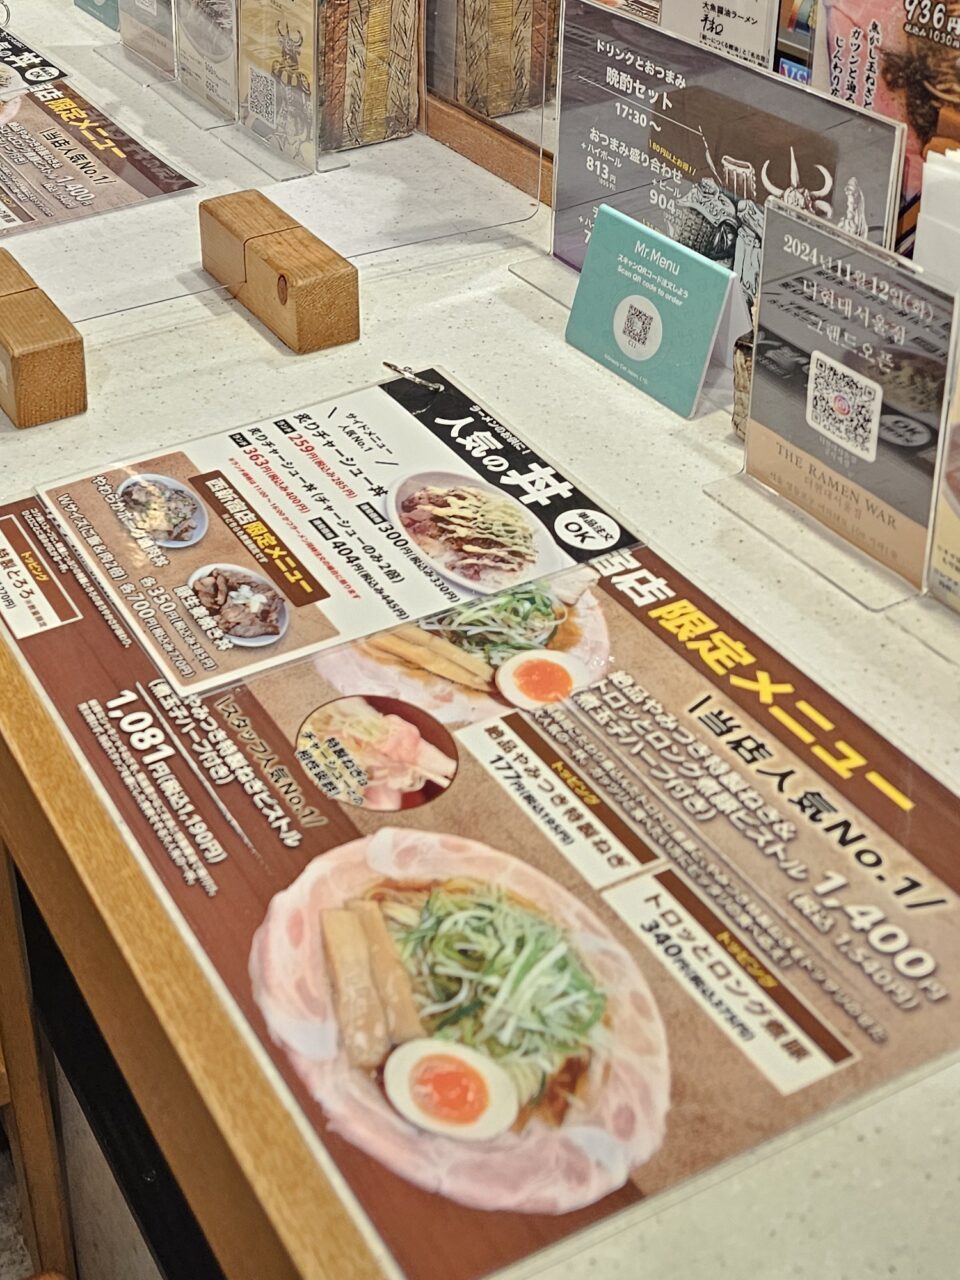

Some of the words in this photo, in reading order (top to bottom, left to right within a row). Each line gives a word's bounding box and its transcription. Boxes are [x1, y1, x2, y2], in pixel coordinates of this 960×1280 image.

[596, 39, 687, 89] ドリンクとおつまみ
[605, 66, 673, 111] 晩酌セット
[586, 156, 617, 184] 813円
[589, 127, 683, 184] おつまみ盛り合わせ
[617, 265, 632, 277] Scan
[642, 278, 657, 292] code
[665, 292, 683, 306] order
[634, 240, 681, 276] Mr.Menu
[293, 412, 389, 499] 炙りチャーシュー丼
[338, 423, 373, 453] 人気No.1
[345, 412, 394, 455] サイドメニュー
[434, 415, 574, 507] 人気の丼
[776, 441, 803, 470] THE
[807, 463, 860, 505] RAMEN
[865, 500, 897, 530] WAR
[204, 477, 314, 594] 西新宿店限定メニュー
[377, 523, 461, 605] 300円(税込み330円)
[564, 521, 596, 544] OK
[332, 540, 410, 621] 404円(税込み445円)
[105, 689, 228, 864] 1,081円(税込1,190円)
[569, 687, 718, 821] (煮玉子ハーフ付き)
[591, 678, 809, 881] トロッとロング煮豚ピストル
[484, 725, 629, 869] 絶品やみつき特製ねぎ
[697, 707, 924, 897] 当店人気No.1
[644, 893, 813, 1063] トロッとロング煮豚
